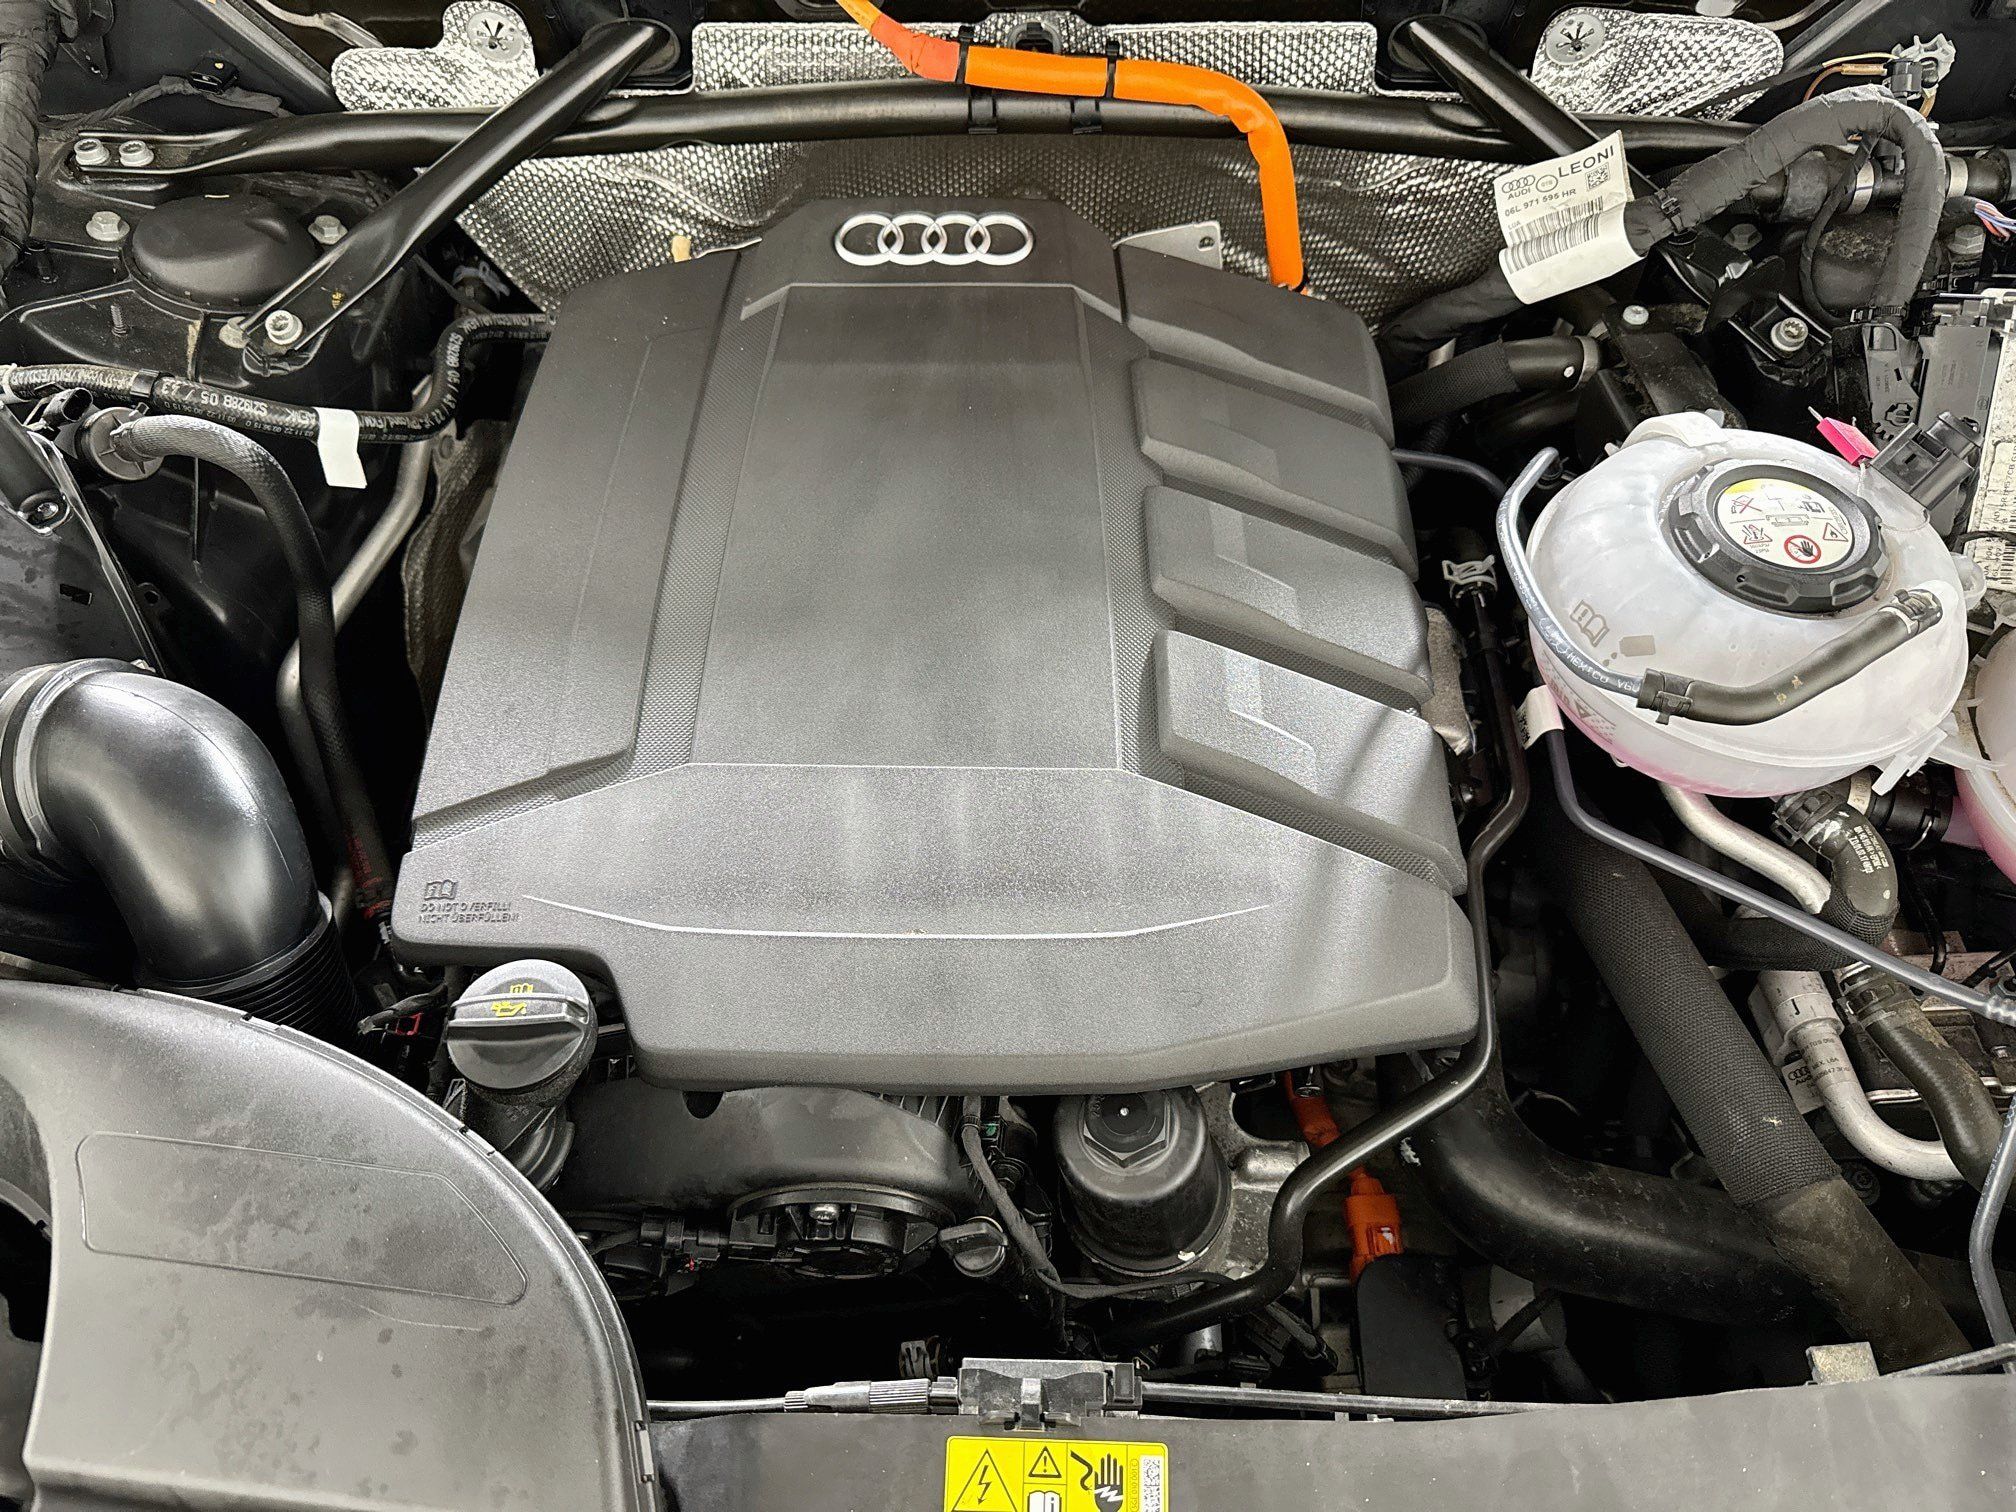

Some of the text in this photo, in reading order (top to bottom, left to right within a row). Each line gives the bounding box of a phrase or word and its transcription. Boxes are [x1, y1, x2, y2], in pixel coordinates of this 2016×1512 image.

[1558, 145, 1614, 177] LEONI
[1507, 187, 1531, 200] AUDI
[1504, 206, 1521, 217] 06L
[1523, 198, 1539, 209] 971
[1562, 188, 1577, 198] HR
[421, 903, 435, 912] DO
[438, 902, 459, 912] NOT
[419, 913, 450, 924] NICHT
